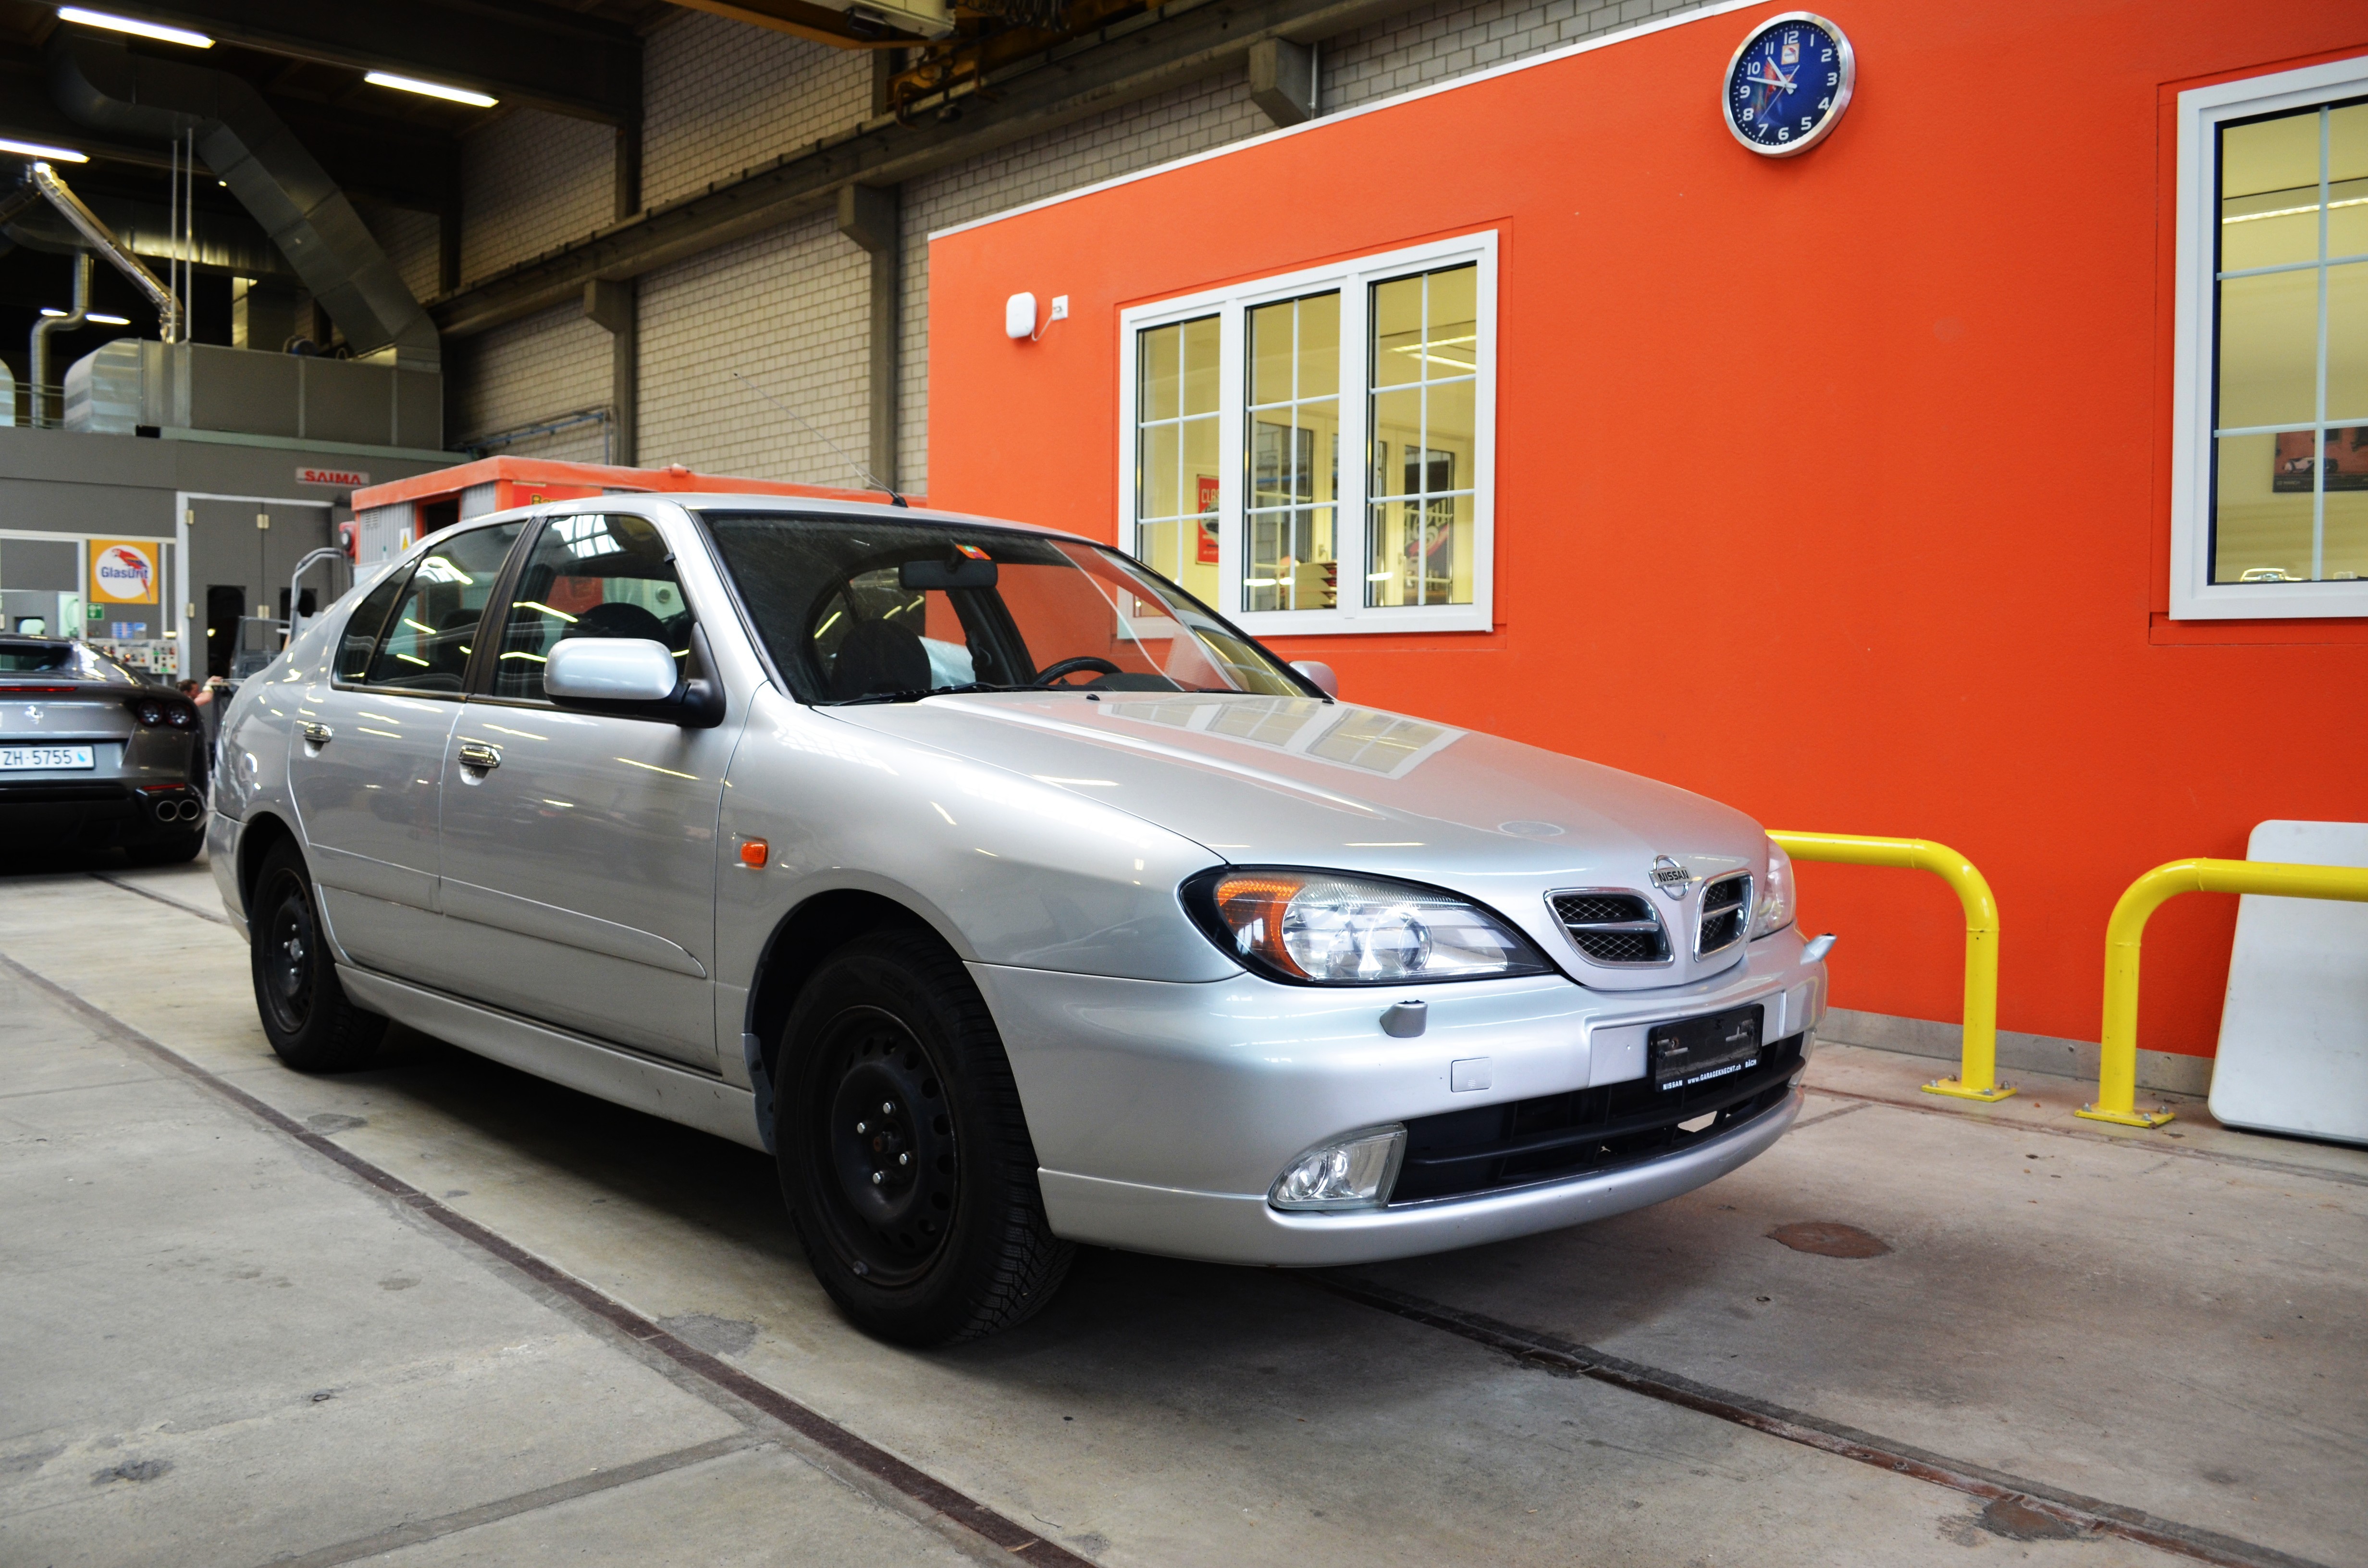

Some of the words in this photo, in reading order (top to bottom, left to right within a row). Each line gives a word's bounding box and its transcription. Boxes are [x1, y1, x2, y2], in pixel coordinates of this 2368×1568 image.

[1784, 30, 1799, 45] 12
[1810, 34, 1814, 47] 1
[1765, 41, 1774, 55] 11
[1821, 49, 1832, 62] 2
[1747, 61, 1761, 75] 10
[1826, 72, 1838, 86] 3
[1740, 86, 1751, 98] 9
[1818, 97, 1830, 110] 4
[1742, 108, 1753, 121] 8
[1758, 123, 1769, 137] 7
[1801, 116, 1812, 130] 5
[1778, 127, 1789, 141] 6
[304, 470, 361, 485] SAIMA
[1657, 870, 1689, 882] NISSAN
[1663, 1080, 1683, 1090] NISSAN
[1688, 1064, 1741, 1084] www.GARAGEKNECHT.ch
